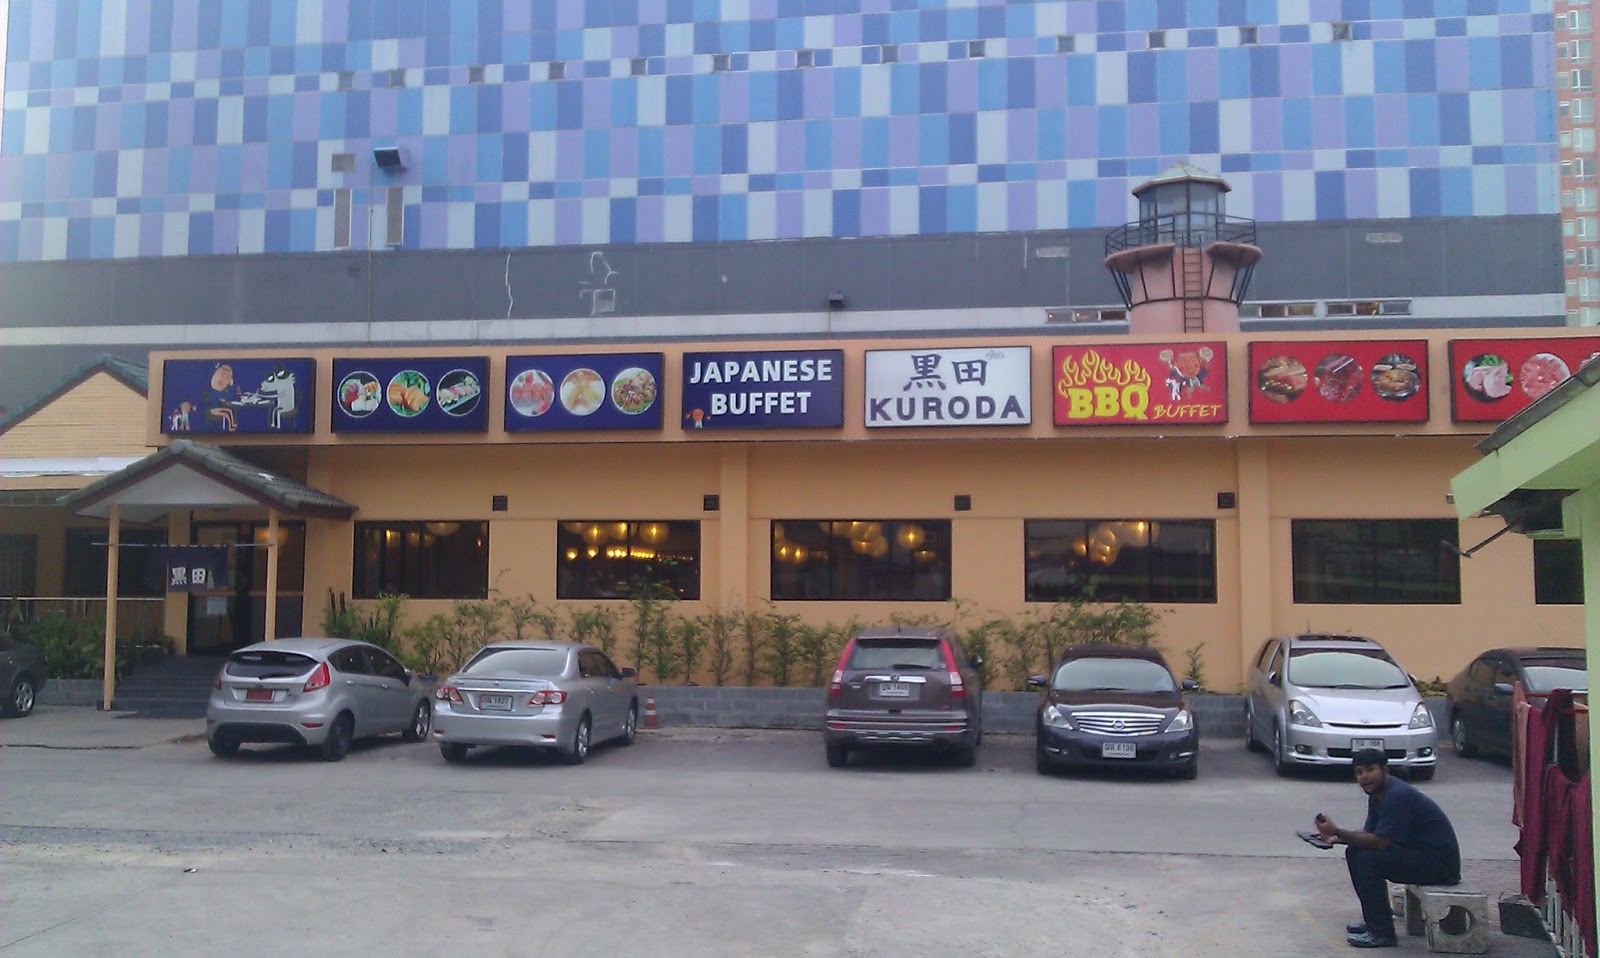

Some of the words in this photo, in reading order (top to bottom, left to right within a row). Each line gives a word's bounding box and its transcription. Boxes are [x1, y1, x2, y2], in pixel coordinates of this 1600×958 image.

[690, 359, 832, 383] JAPANESE
[903, 353, 988, 391] 黒田
[710, 391, 812, 416] BUFFET
[869, 395, 1026, 422] KURODA
[1068, 383, 1150, 420] BBQ
[1152, 404, 1222, 420] BUFFET
